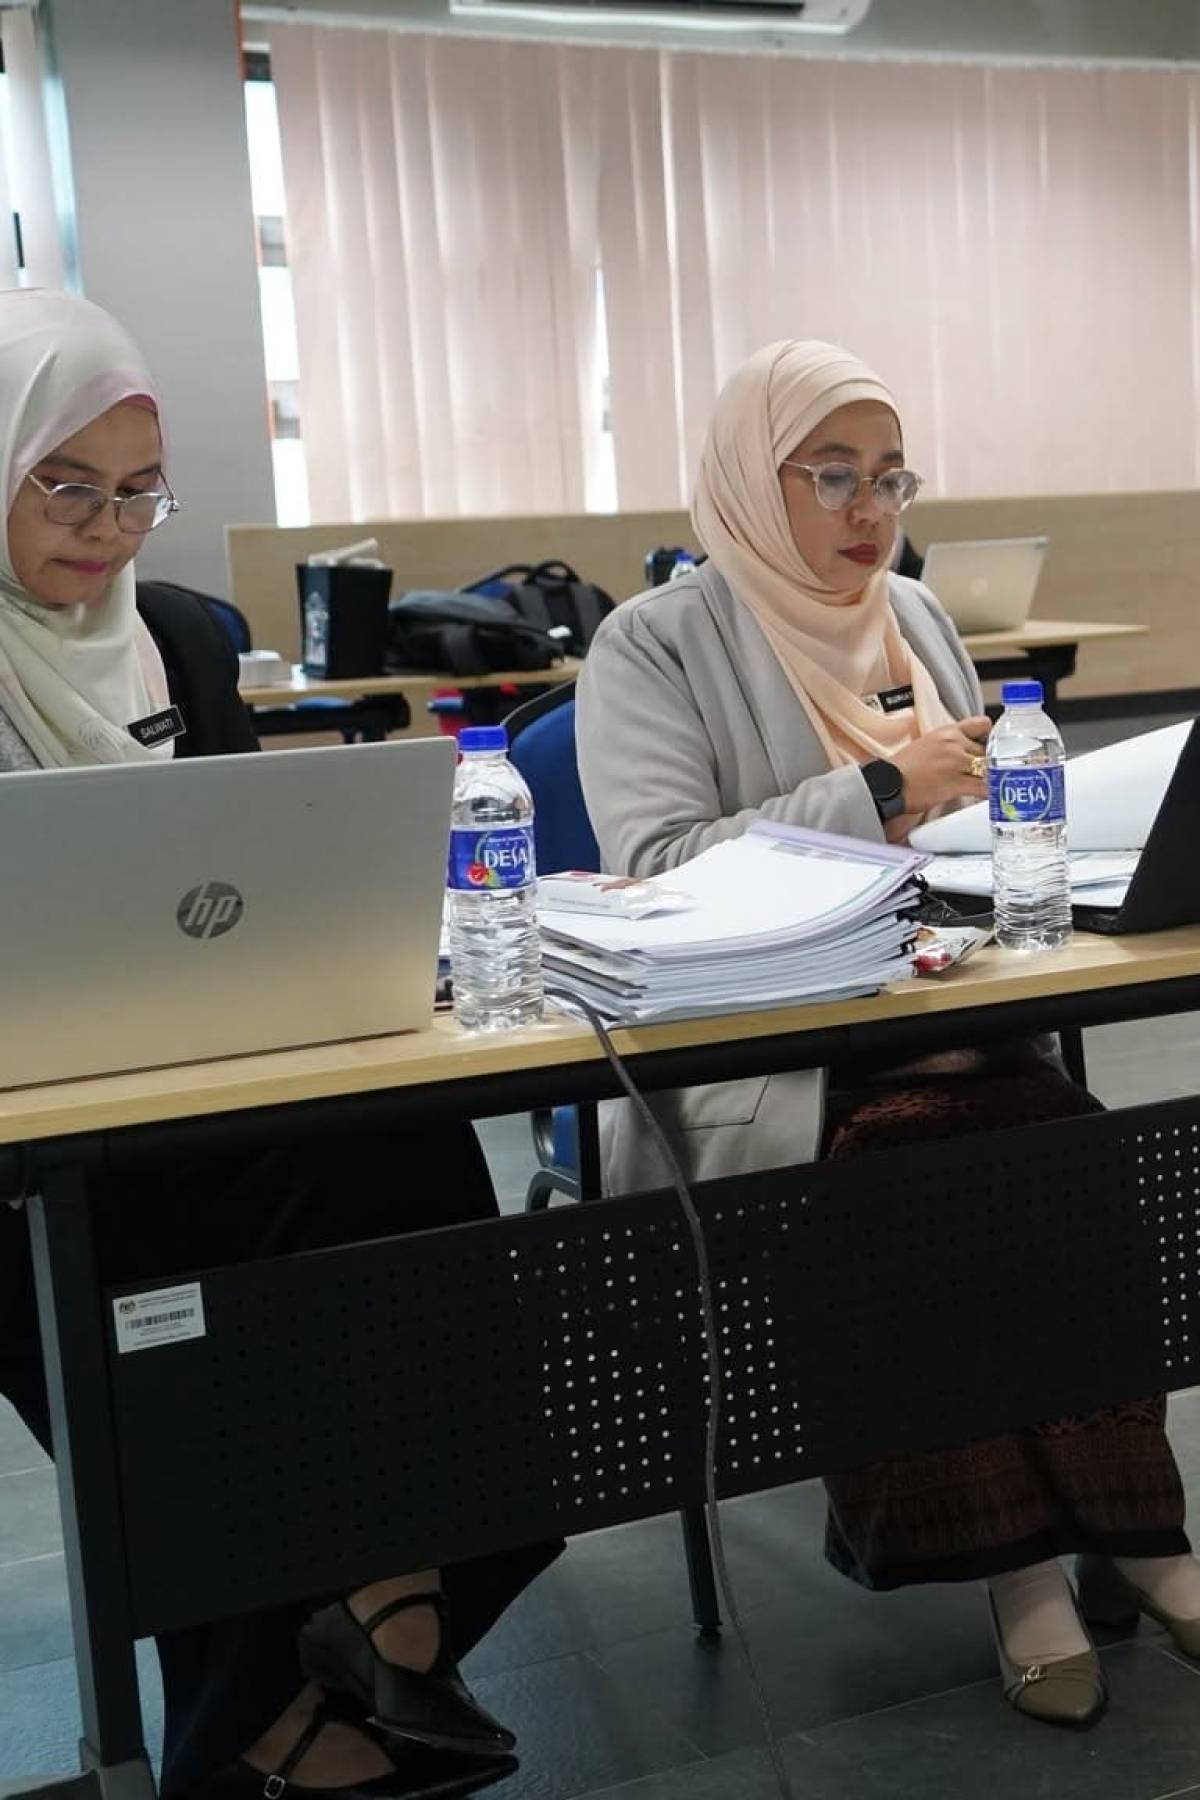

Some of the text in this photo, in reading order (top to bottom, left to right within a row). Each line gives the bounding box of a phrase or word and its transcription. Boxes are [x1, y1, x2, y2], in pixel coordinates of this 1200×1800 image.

[1004, 785, 1046, 805] DESA
[484, 847, 528, 869] DESA
[184, 881, 238, 939] hp
